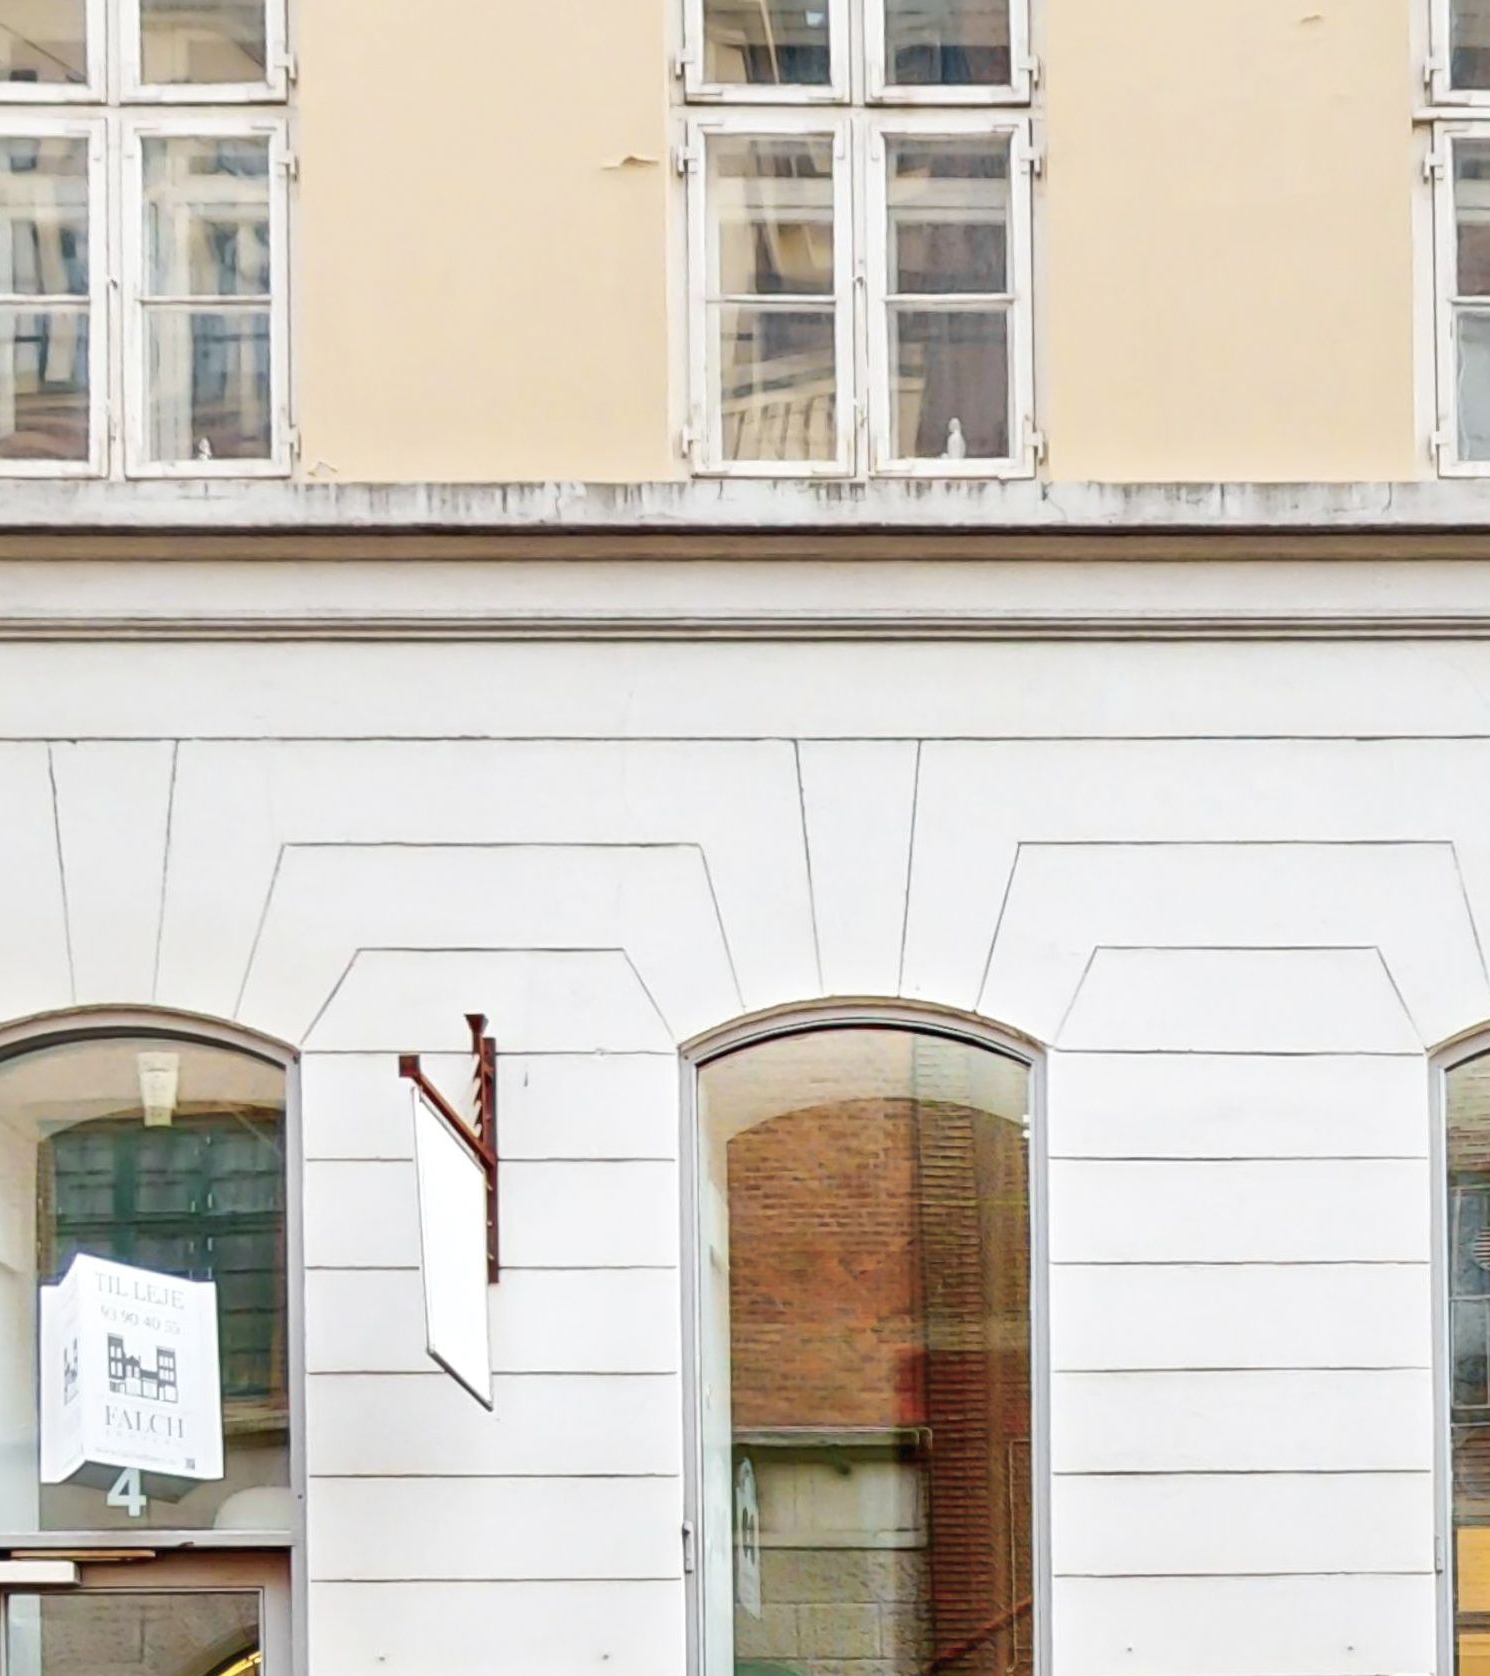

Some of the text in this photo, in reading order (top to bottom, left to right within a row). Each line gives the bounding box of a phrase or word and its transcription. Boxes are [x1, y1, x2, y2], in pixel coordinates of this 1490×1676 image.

[94, 1272, 185, 1310] TIL LEJE
[121, 1309, 139, 1326] 90
[143, 1315, 161, 1331] 40
[104, 1405, 184, 1439] FALCH
[107, 1468, 147, 1517] 4
